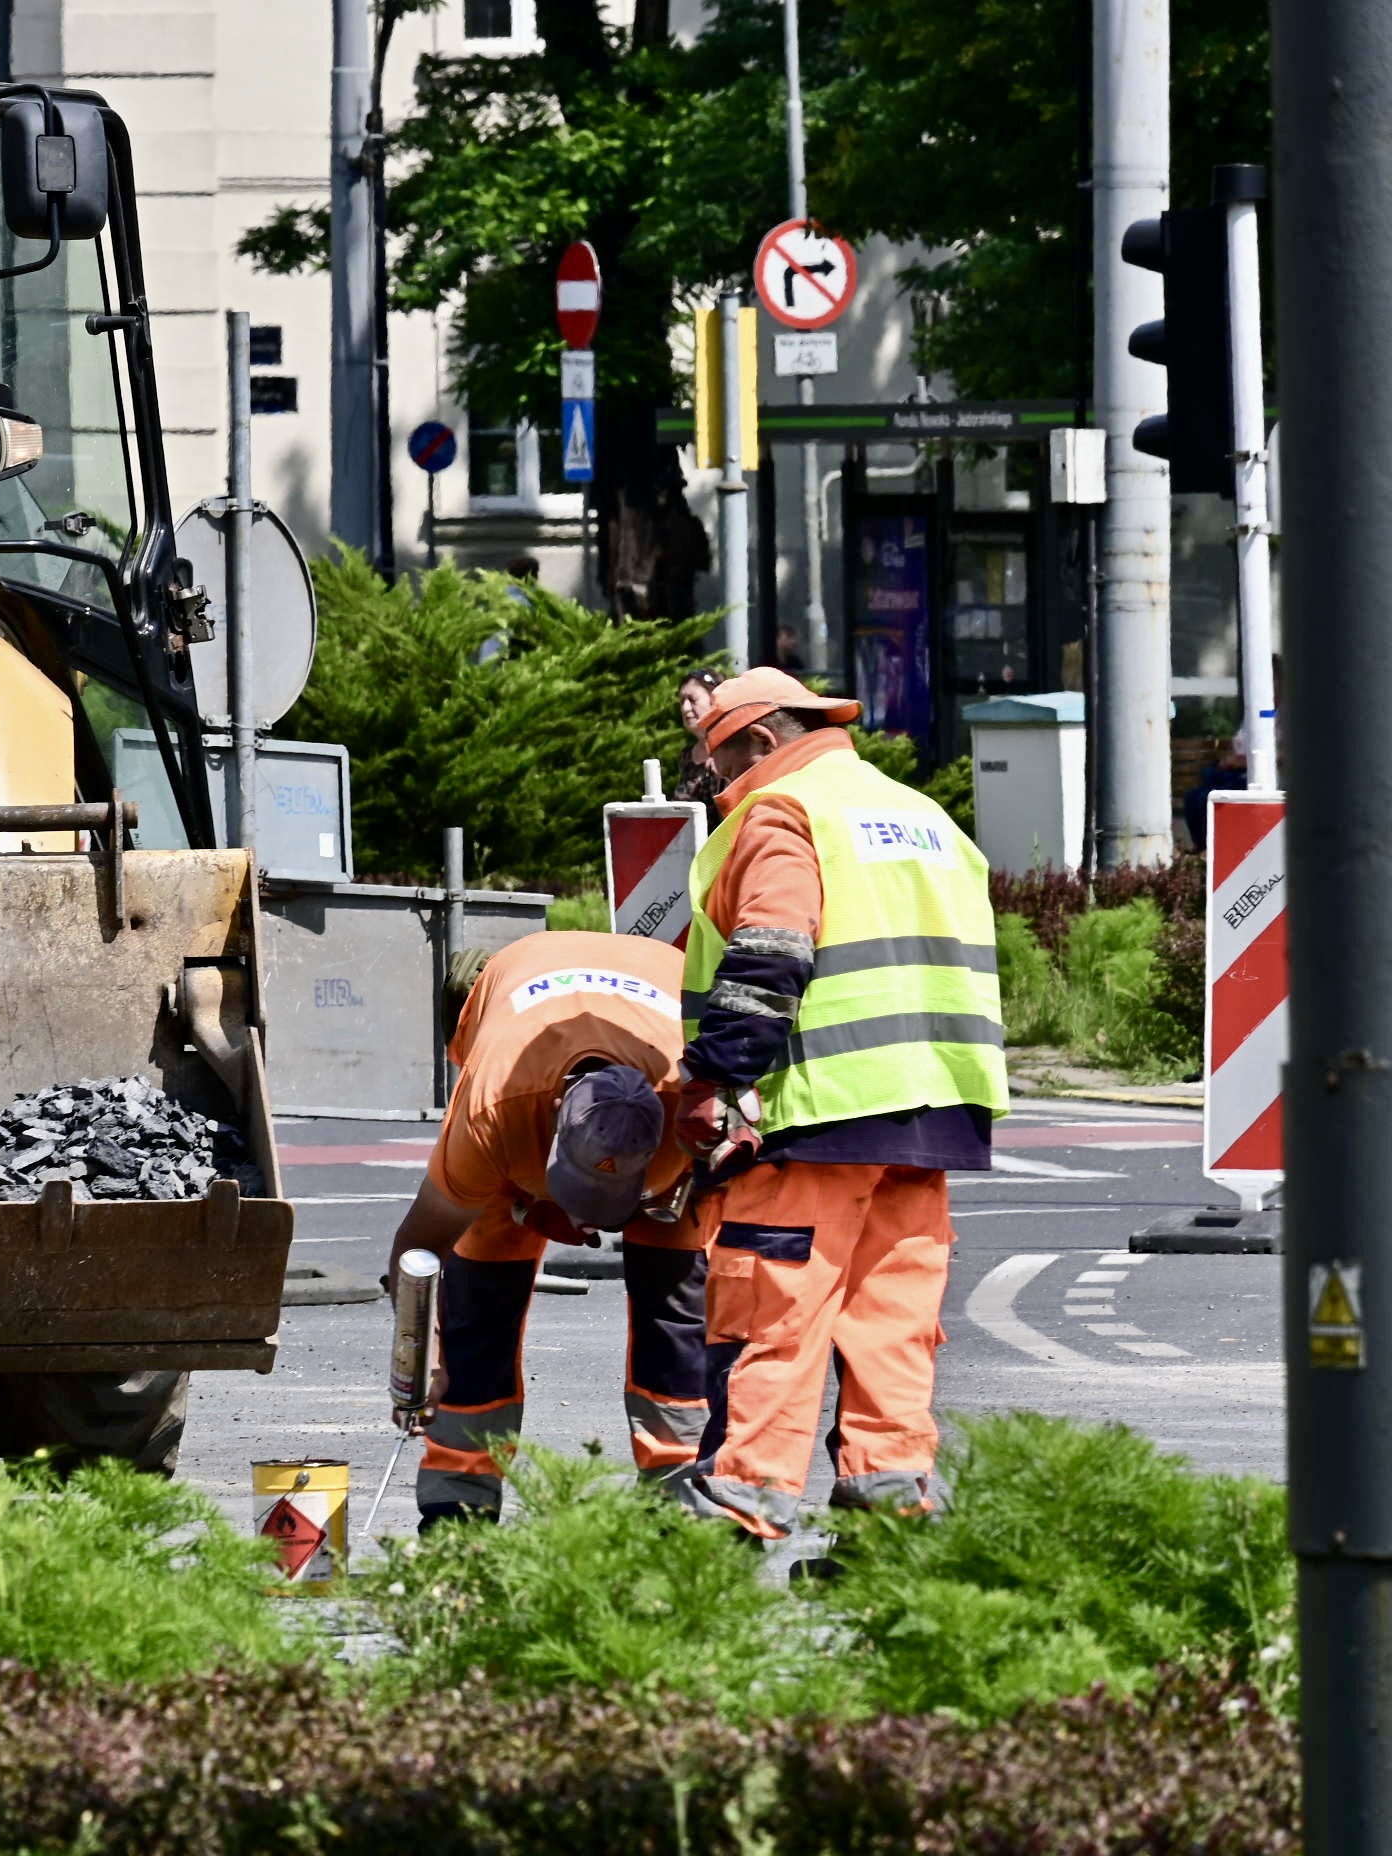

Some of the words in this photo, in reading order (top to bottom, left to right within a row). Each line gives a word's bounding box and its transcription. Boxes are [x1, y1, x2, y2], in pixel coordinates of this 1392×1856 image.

[859, 822, 943, 853] TERLAN
[314, 977, 365, 1008] BUD
[527, 973, 659, 999] TERLAN
